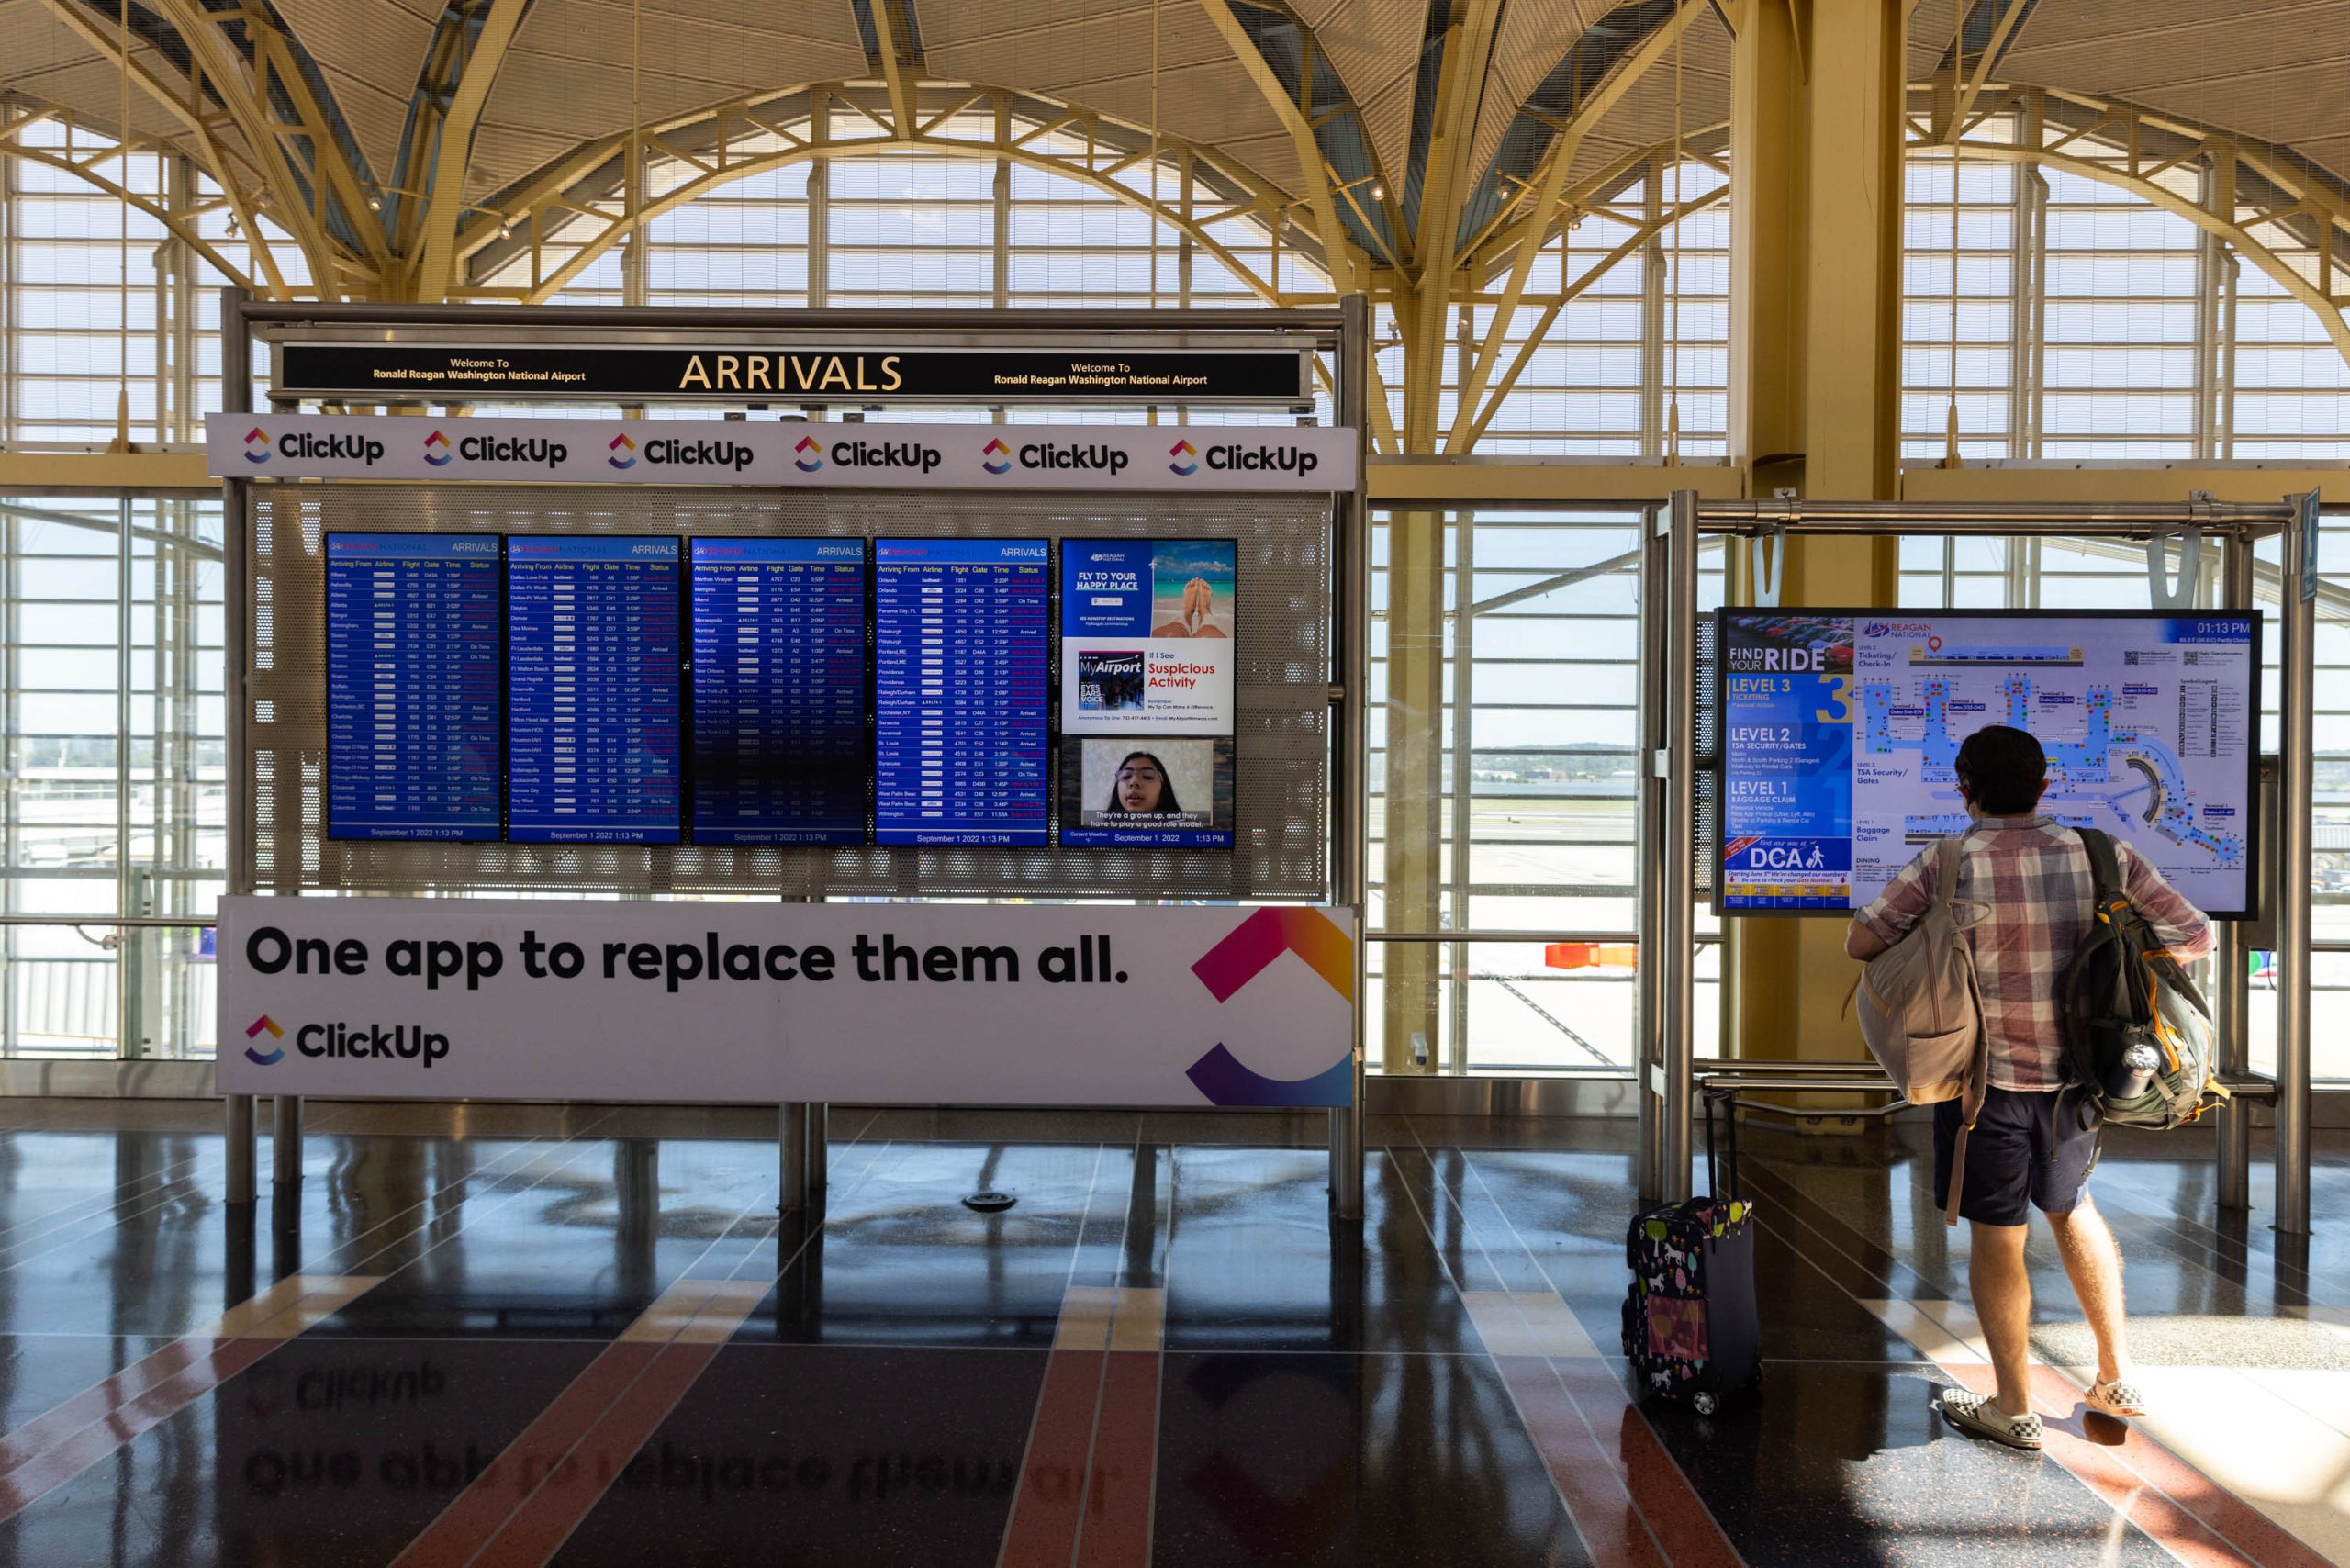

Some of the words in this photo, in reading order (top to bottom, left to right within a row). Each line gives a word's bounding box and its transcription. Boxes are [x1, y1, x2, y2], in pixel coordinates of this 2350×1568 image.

[450, 358, 495, 368] Welcome
[497, 358, 509, 368] To
[1071, 363, 1116, 373] Welcome
[1118, 363, 1131, 373] To
[373, 369, 408, 379] Ronald
[409, 369, 445, 382] Reagan
[447, 370, 506, 383] Washington
[508, 371, 549, 381] National
[551, 371, 587, 384] Airport
[678, 355, 902, 391] ARRIVALS
[994, 375, 1028, 385] Ronald
[1030, 375, 1066, 386] Reagan
[1068, 375, 1126, 387] Washington
[1129, 375, 1169, 385] National
[1172, 375, 1208, 387] Airport
[278, 433, 384, 465] ClickUp
[460, 436, 567, 468] ClickUp
[643, 439, 754, 471] ClickUp
[831, 441, 942, 474] ClickUp
[1019, 442, 1128, 476] ClickUp
[1205, 444, 1318, 477] ClickUp
[452, 543, 498, 553] ARRIVALS
[632, 545, 677, 555] ARRIVALS
[816, 546, 863, 556] ARRIVALS
[1001, 548, 1046, 557] ARRIVALS
[330, 561, 354, 569] Arriving
[402, 561, 420, 569] Flight
[510, 563, 534, 572] Arriving
[582, 564, 599, 572] Flight
[694, 566, 719, 574] Arriving
[767, 566, 784, 574] Flight
[878, 566, 902, 575] Arriving
[950, 566, 968, 575] Flight
[1078, 572, 1093, 580] FLY
[1095, 572, 1108, 580] TO
[1111, 572, 1136, 581] YOUR
[1077, 581, 1107, 590] HAPPY
[1110, 581, 1138, 590] PLACE
[1891, 623, 1932, 632] REAGAN
[2197, 622, 2229, 633] 01:13
[2232, 622, 2250, 633] PM
[1729, 647, 1763, 660] FIND
[1858, 651, 1897, 661] Ticketing/
[1764, 648, 1825, 671] RIDE
[1080, 661, 1142, 676] MyAirport
[1148, 663, 1215, 676] Suspicious
[1729, 660, 1762, 671] YOUR
[1148, 677, 1196, 689] Activity
[1732, 678, 1777, 692] LEVEL
[1781, 678, 1791, 693] 3
[1732, 693, 1770, 701] TICKETING
[1731, 727, 1775, 742] LEVEL
[1780, 727, 1790, 742] 2
[1731, 742, 1745, 750] TSA
[1746, 742, 1807, 750] SECURITY/GATES
[1872, 768, 1908, 778] Security/
[1730, 781, 1775, 795] LEVEL
[1781, 781, 1787, 795] 1
[1096, 812, 1123, 820] They're
[1181, 812, 1198, 821] they
[1118, 820, 1135, 828] play
[1143, 820, 1161, 828] good
[370, 828, 408, 837] September
[1856, 826, 1891, 835] Baggage
[550, 832, 588, 841] September
[917, 834, 955, 844] September
[1114, 834, 1152, 844] September
[1195, 834, 1211, 843] 1:13
[1212, 834, 1225, 843] PM
[1751, 847, 1804, 868] DCA
[246, 926, 368, 975] One
[386, 938, 504, 991] app
[520, 930, 585, 980] to
[603, 932, 836, 993] replace
[852, 933, 1020, 983] them
[1037, 934, 1129, 984] all.
[296, 1022, 450, 1069] ClickUp
